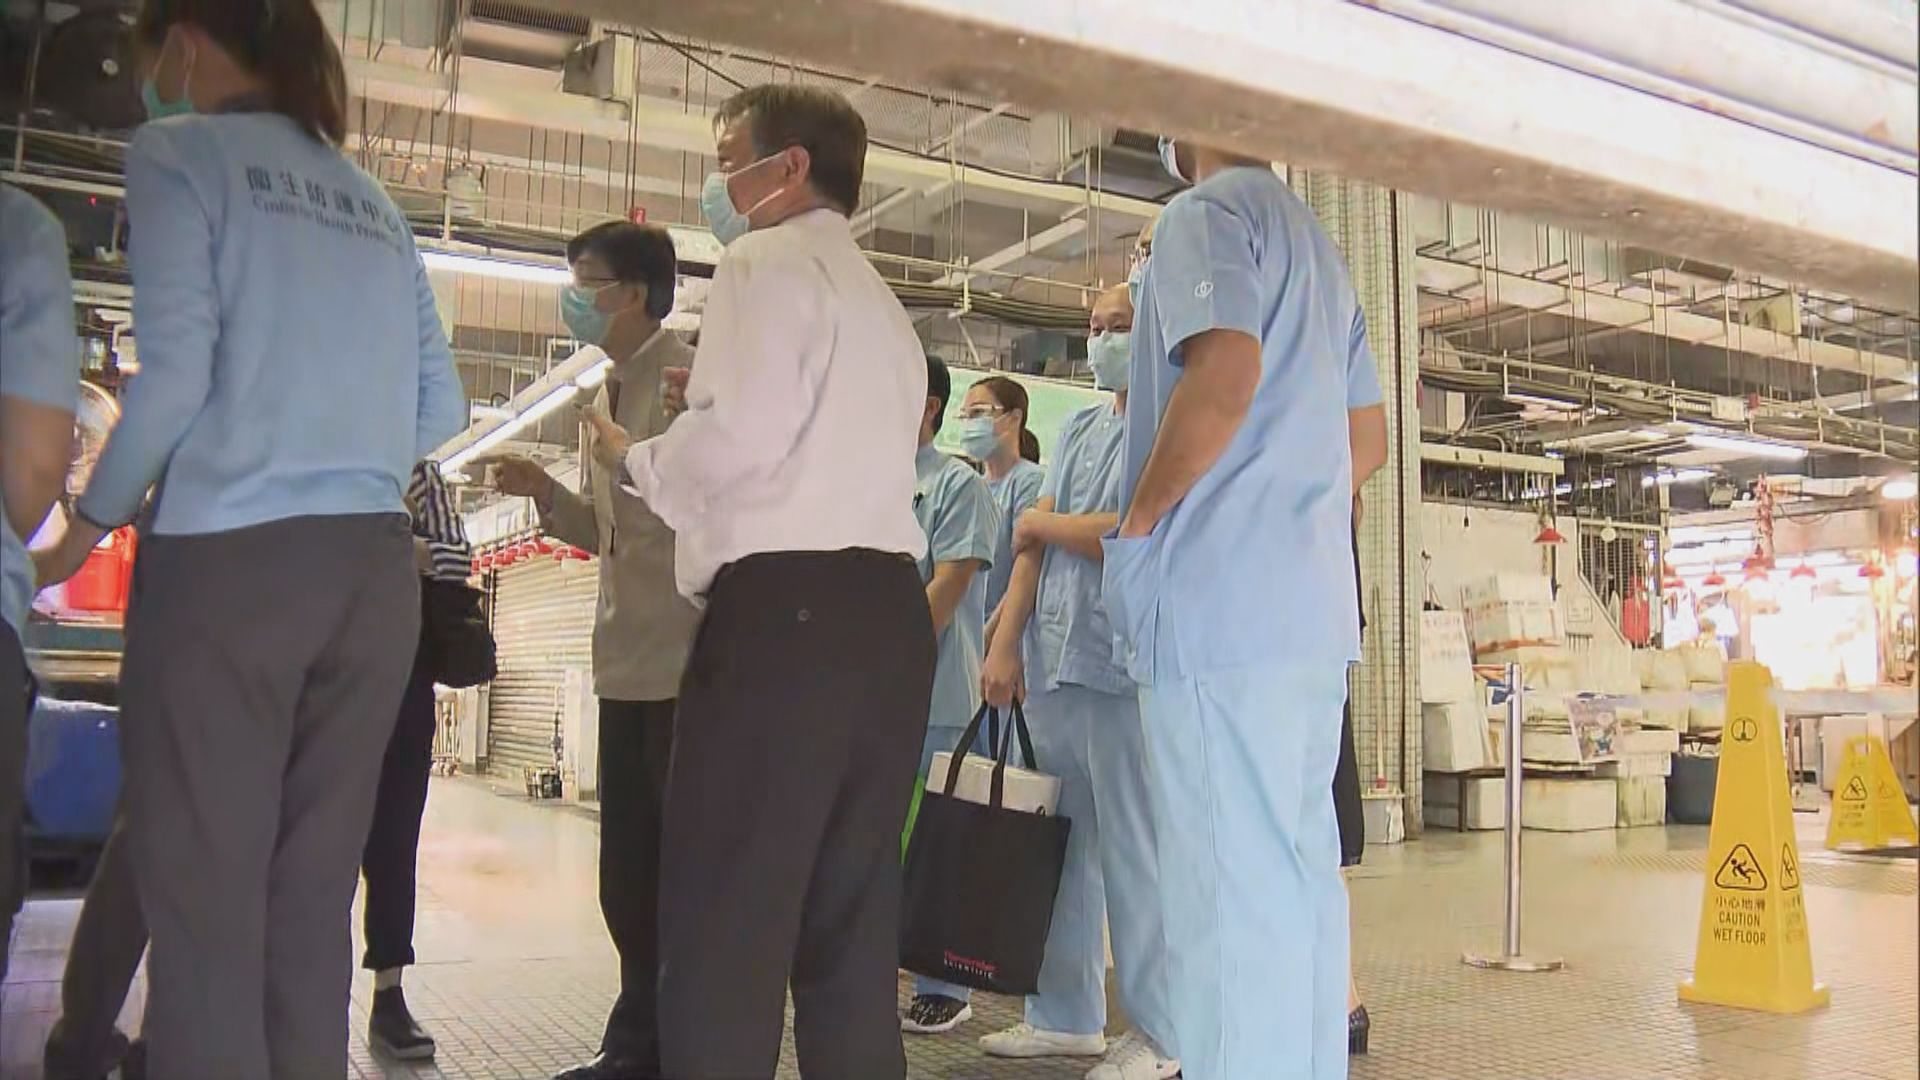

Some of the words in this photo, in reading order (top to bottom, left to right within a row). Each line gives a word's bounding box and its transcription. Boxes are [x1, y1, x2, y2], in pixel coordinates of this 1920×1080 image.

[1719, 911, 1761, 927] CAUTION
[1713, 927, 1733, 942] WET
[1735, 929, 1767, 945] FLOOR
